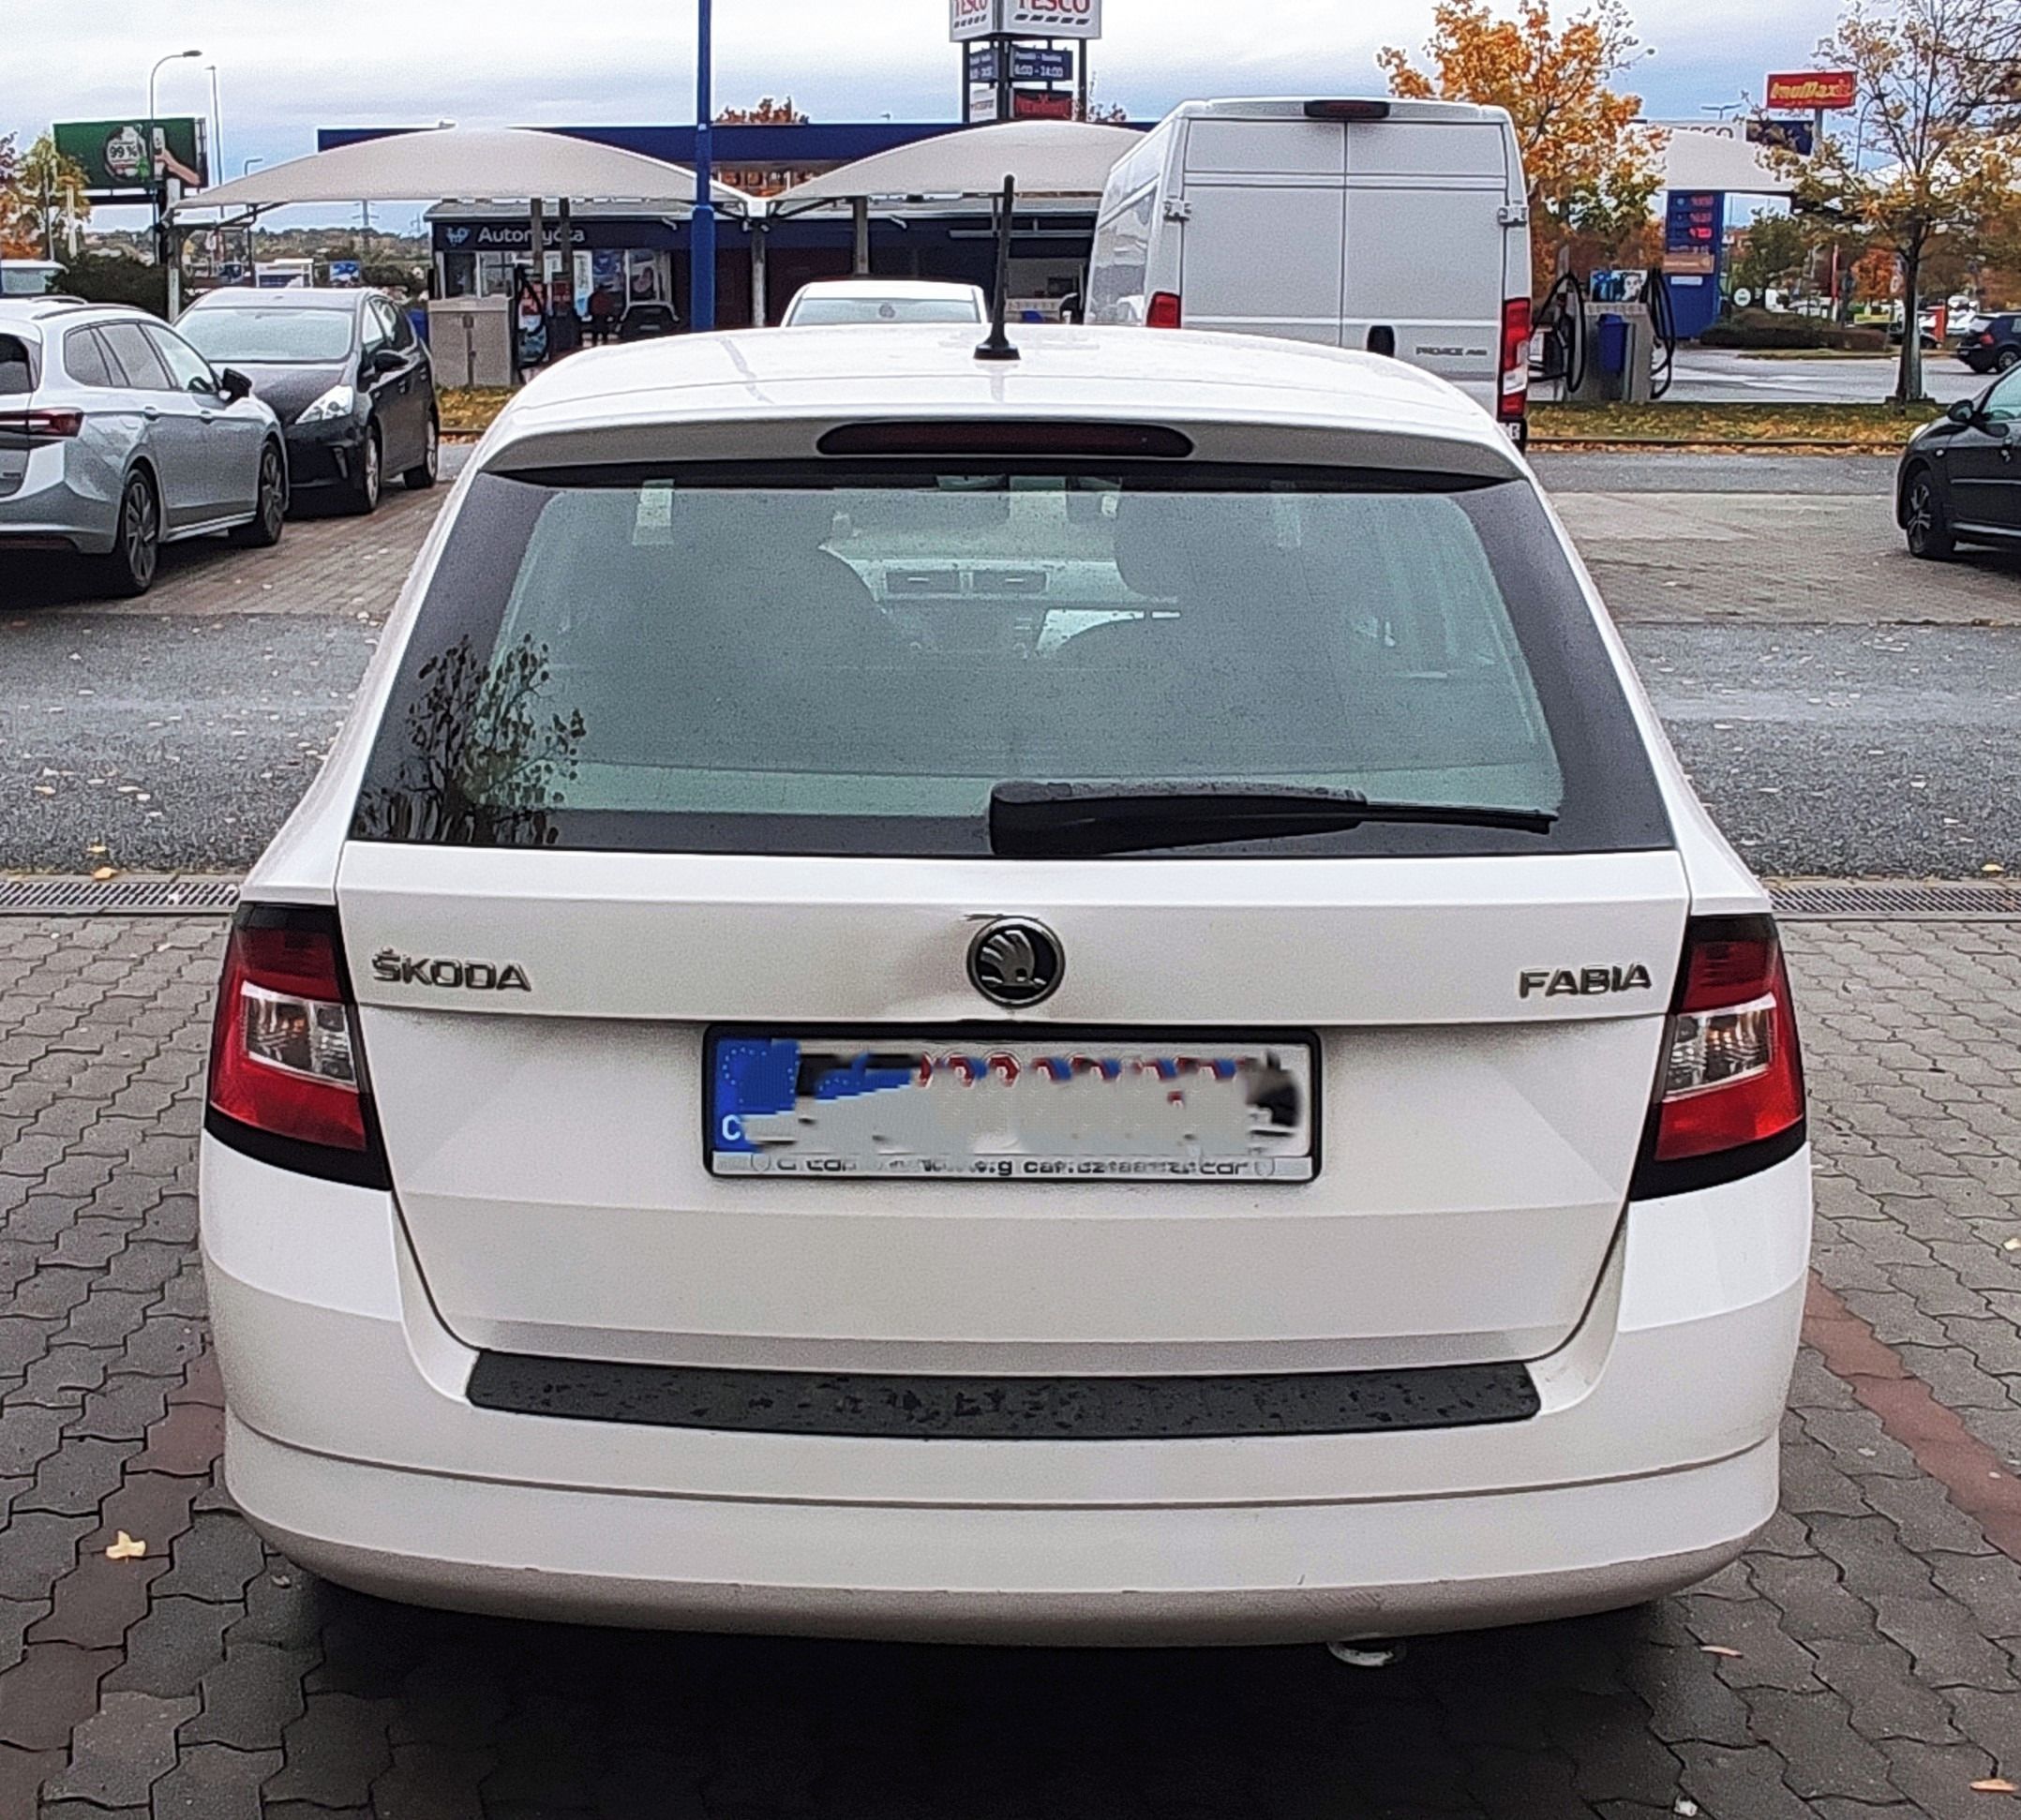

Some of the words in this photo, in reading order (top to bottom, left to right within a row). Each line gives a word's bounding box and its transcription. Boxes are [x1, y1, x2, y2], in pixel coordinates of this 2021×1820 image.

[109, 146, 124, 158] 99
[371, 946, 531, 992] ŠKODA
[1519, 962, 1653, 999] FABIA
